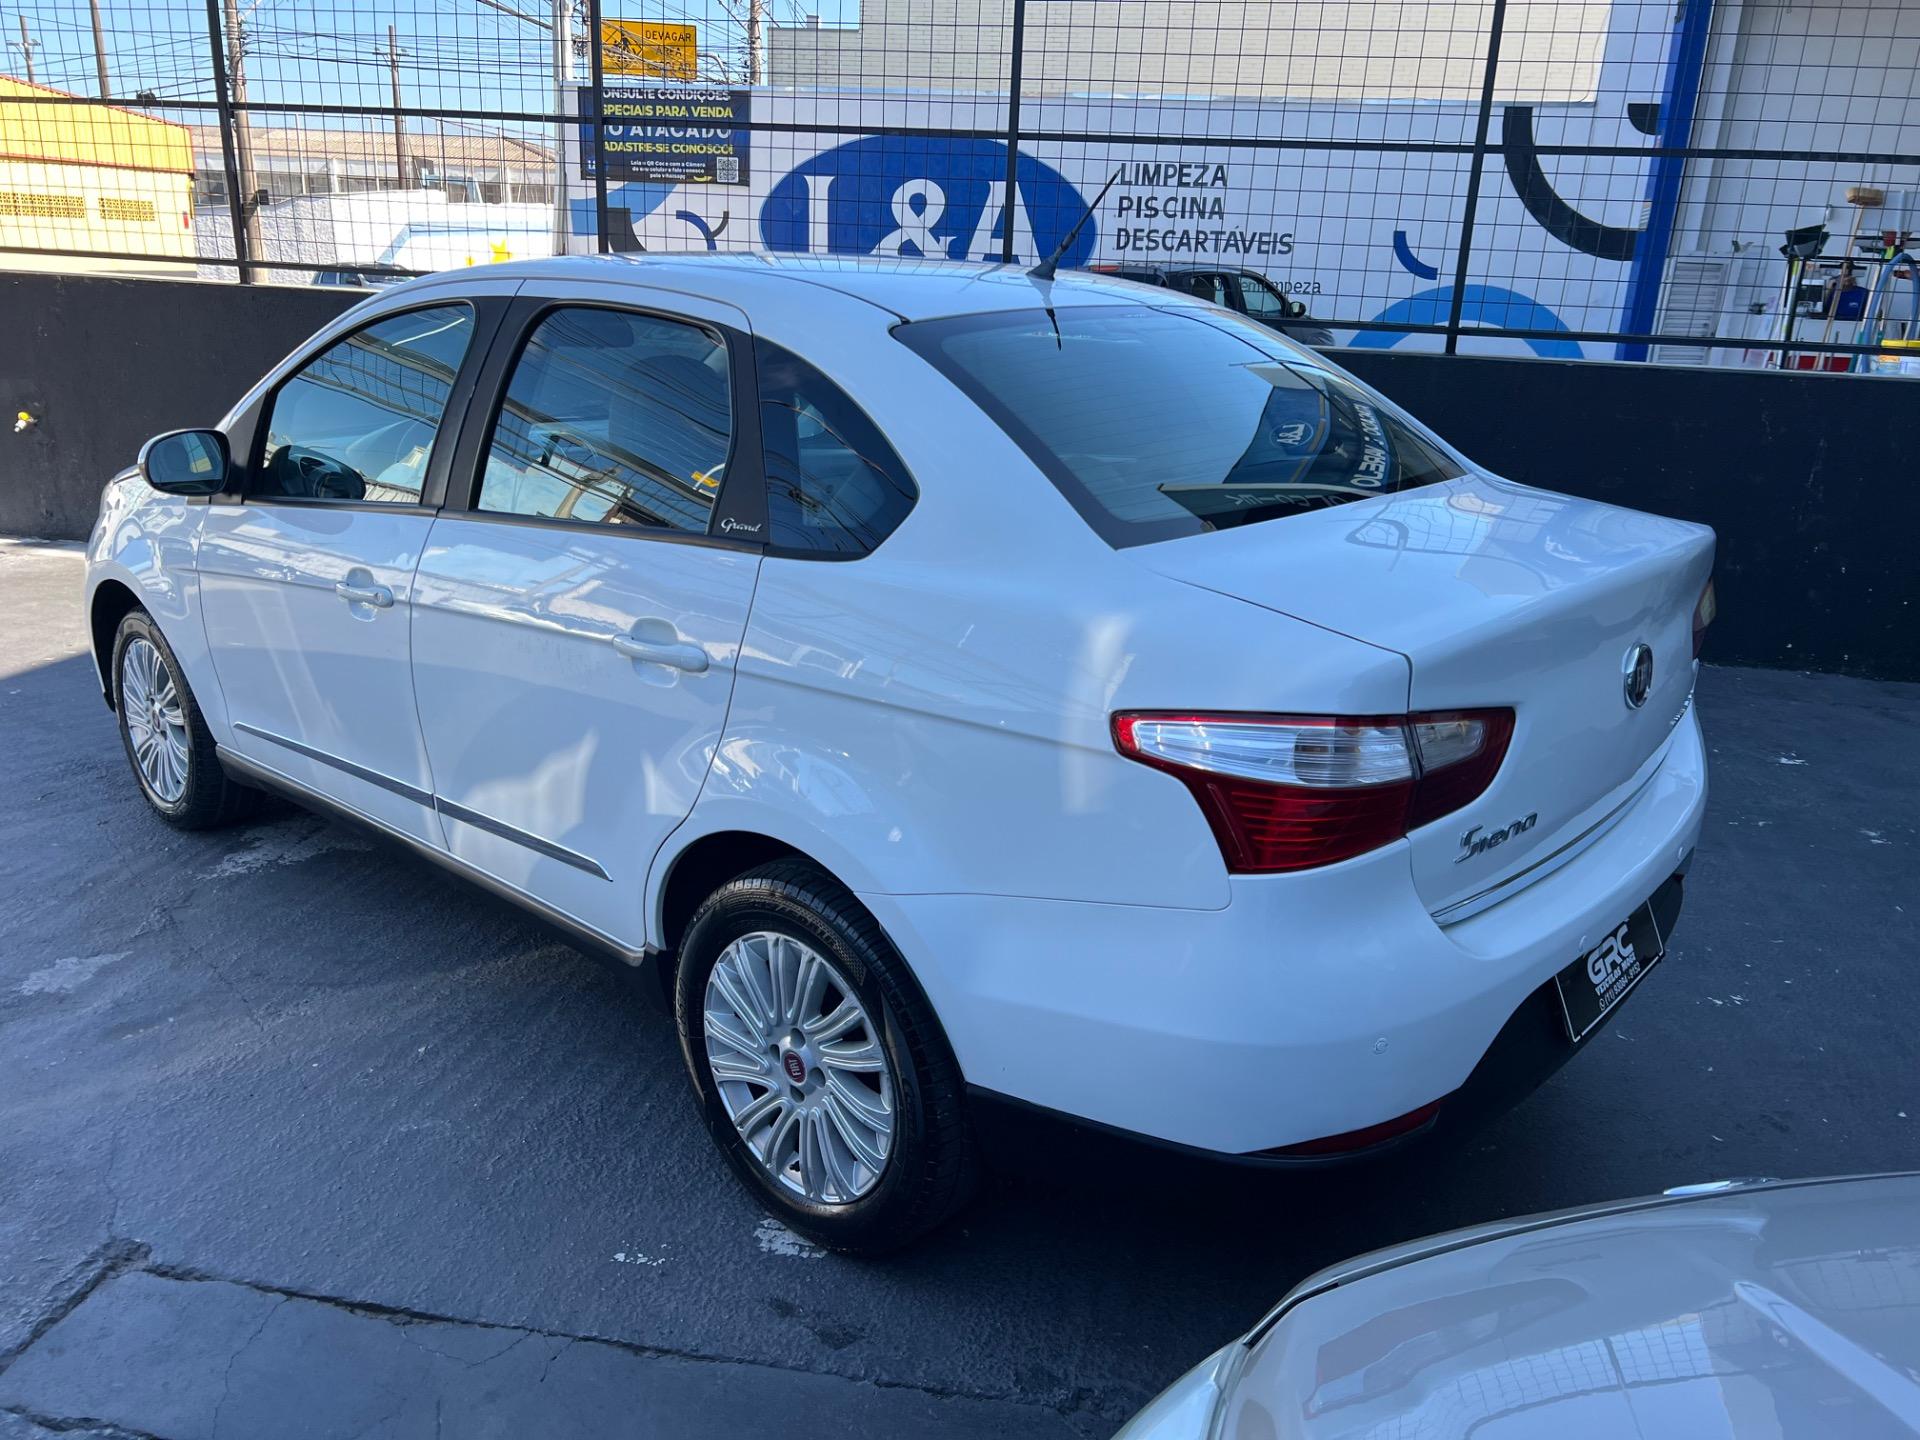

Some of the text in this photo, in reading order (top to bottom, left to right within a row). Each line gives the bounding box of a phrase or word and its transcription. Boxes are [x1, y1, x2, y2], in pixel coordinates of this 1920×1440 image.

[645, 30, 692, 42] DEVAGAR
[603, 88, 656, 99] ONSULTE
[603, 104, 734, 118] SPECIAIS PARA VENDA
[604, 124, 732, 139] O ATACADO
[604, 141, 669, 153] ADASTRE-SE
[1120, 162, 1228, 187] LIMPEZA
[1117, 195, 1224, 220] PISCINA
[1115, 225, 1293, 255] DESCARTÁVEIS
[721, 517, 762, 533] Grand
[1453, 812, 1538, 864] Siena
[1587, 923, 1634, 985] GRC
[788, 1059, 802, 1077] FIAT
